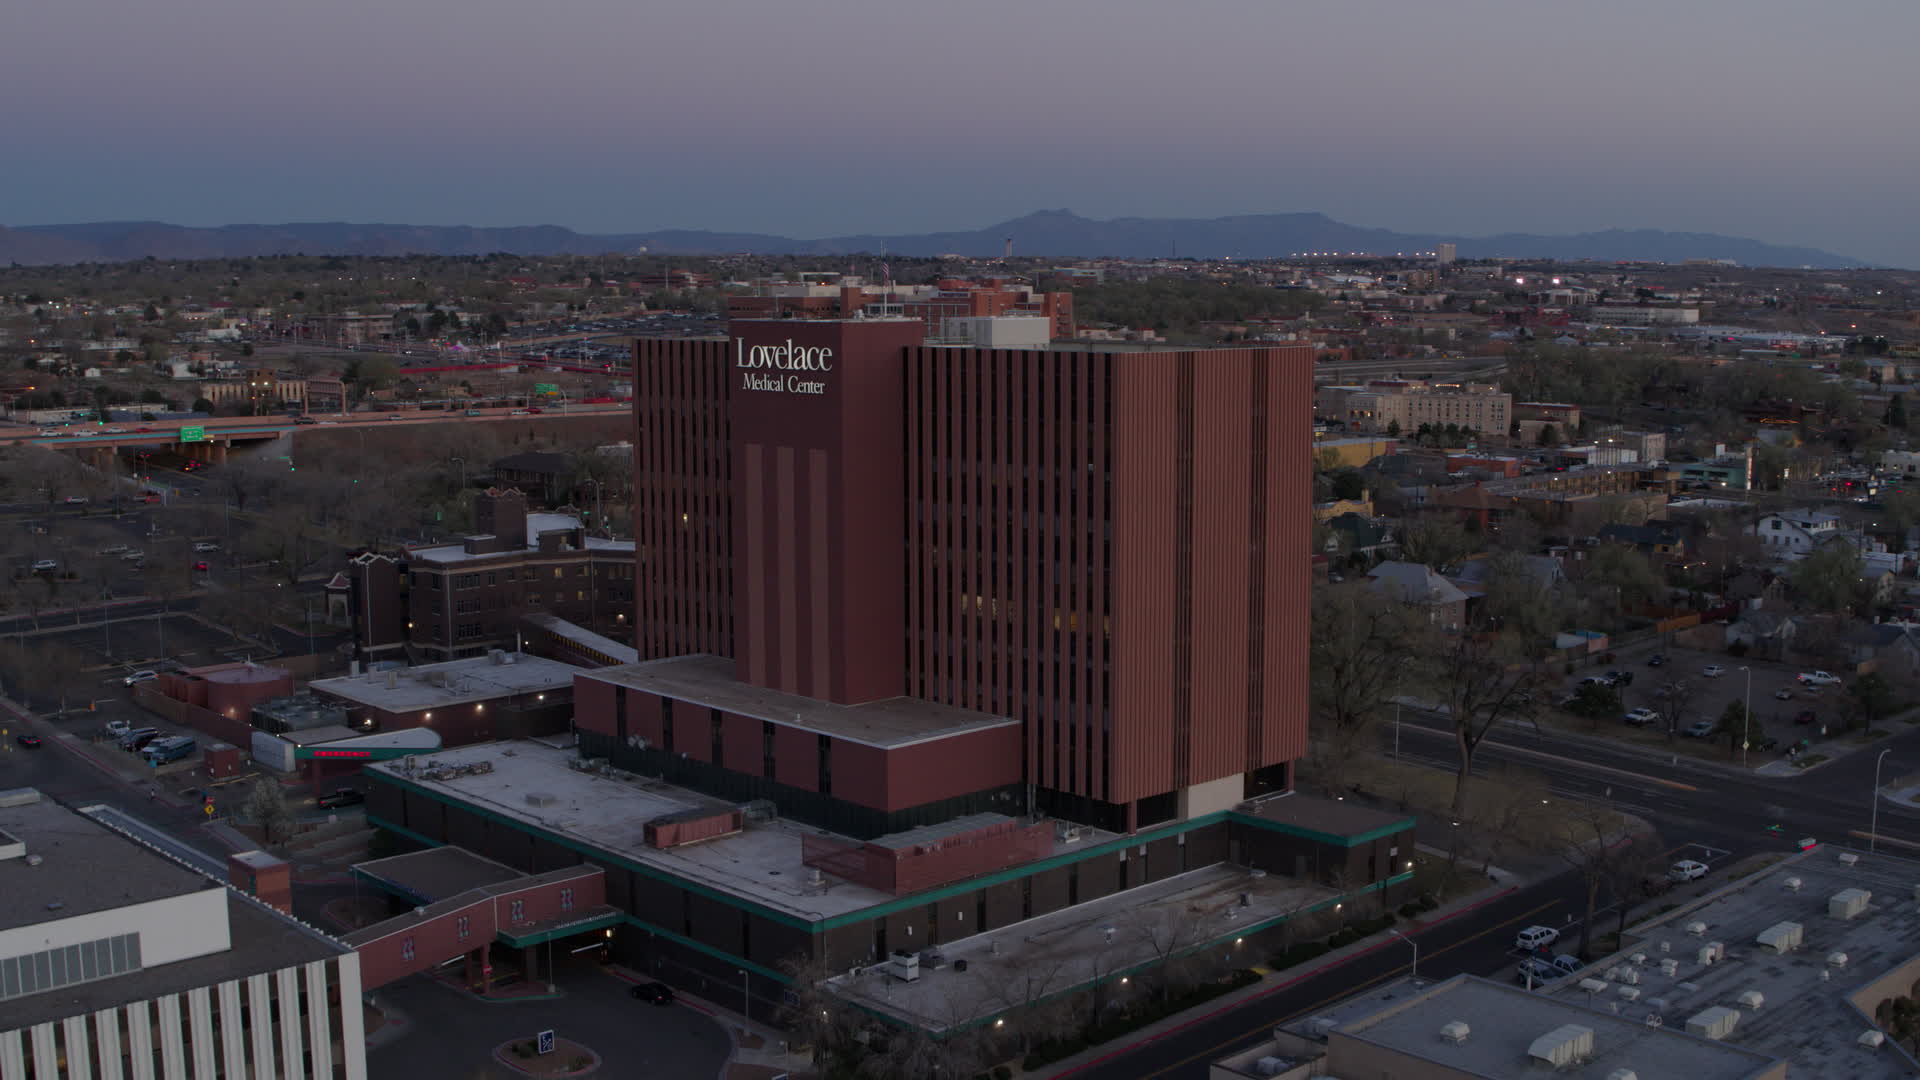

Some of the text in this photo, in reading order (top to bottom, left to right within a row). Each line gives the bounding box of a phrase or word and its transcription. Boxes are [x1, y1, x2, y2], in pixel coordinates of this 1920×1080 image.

[736, 337, 833, 371] Lovelace
[742, 372, 826, 394] Medical Center
